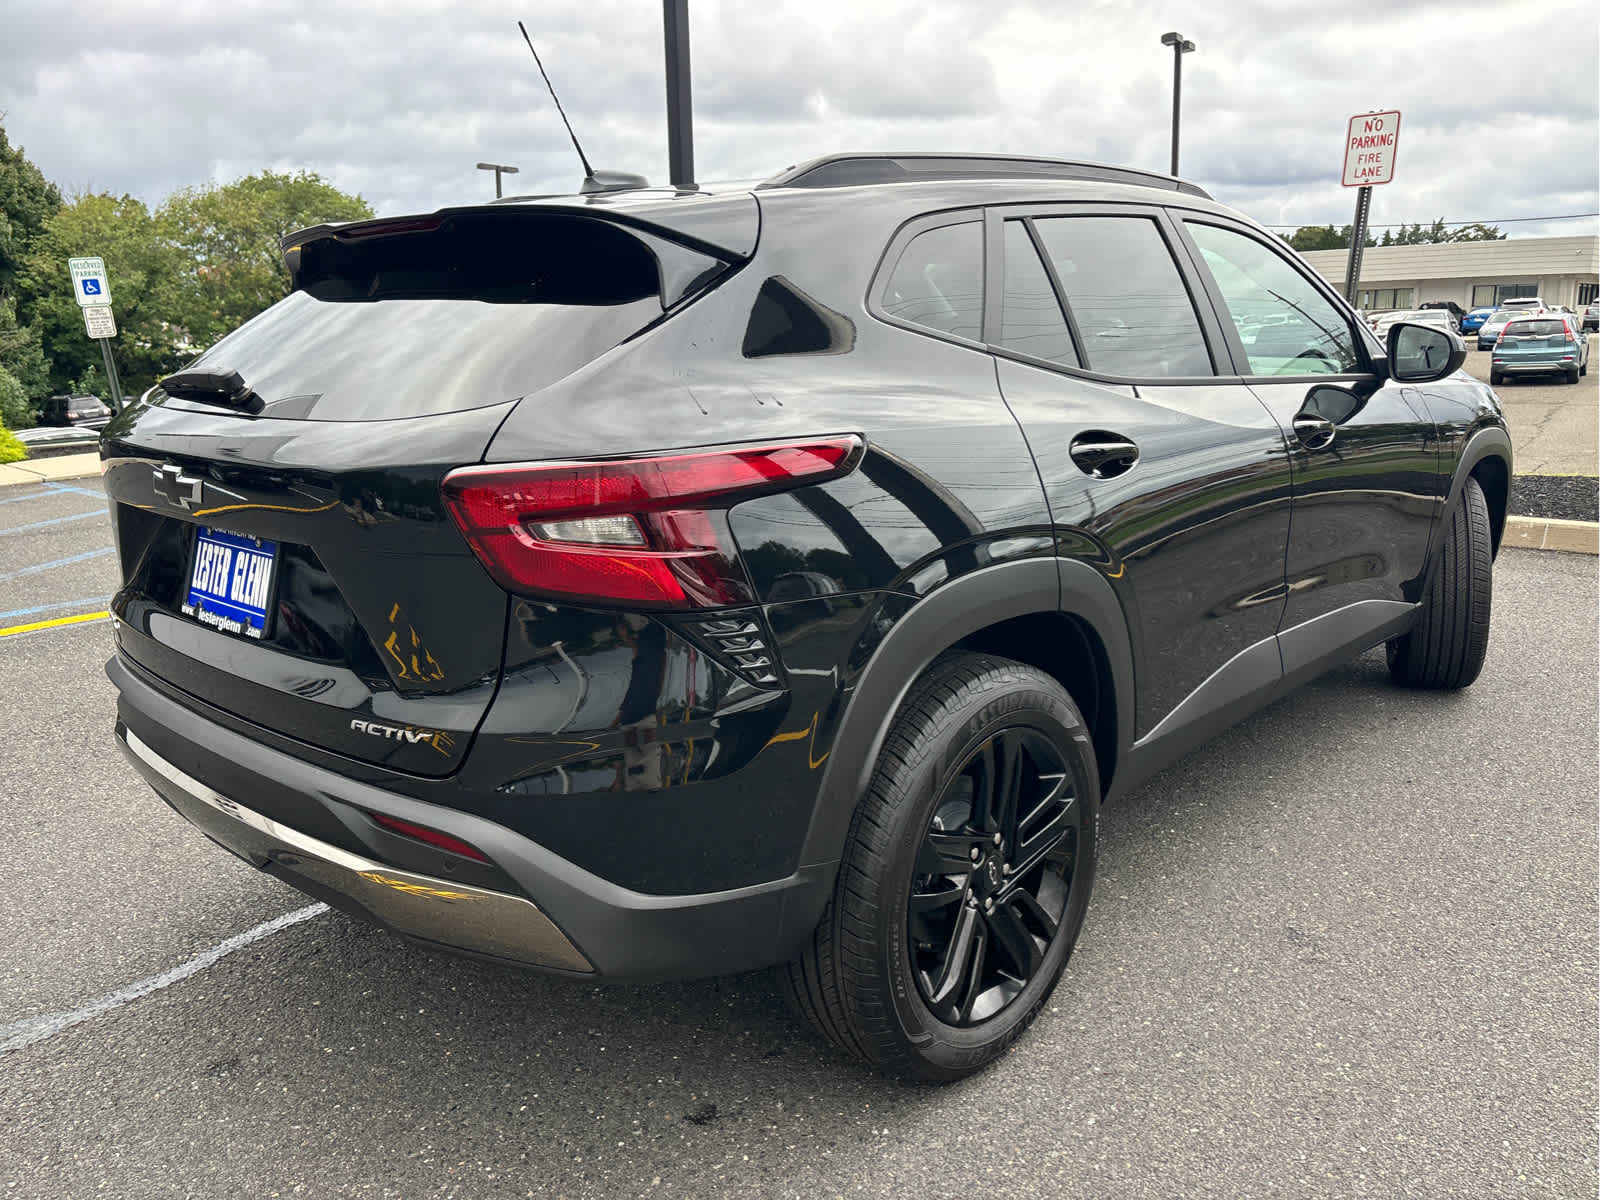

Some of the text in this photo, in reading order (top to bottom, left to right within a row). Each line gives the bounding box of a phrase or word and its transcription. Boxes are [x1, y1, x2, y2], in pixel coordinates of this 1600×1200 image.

[1364, 119, 1384, 133] NO
[1351, 133, 1394, 149] PARKING
[1358, 152, 1382, 164] FIRE
[1354, 166, 1383, 178] LANE
[72, 262, 103, 270] RESERVED
[191, 541, 273, 610] LESTER GLENN
[350, 719, 433, 744] ACTIV
